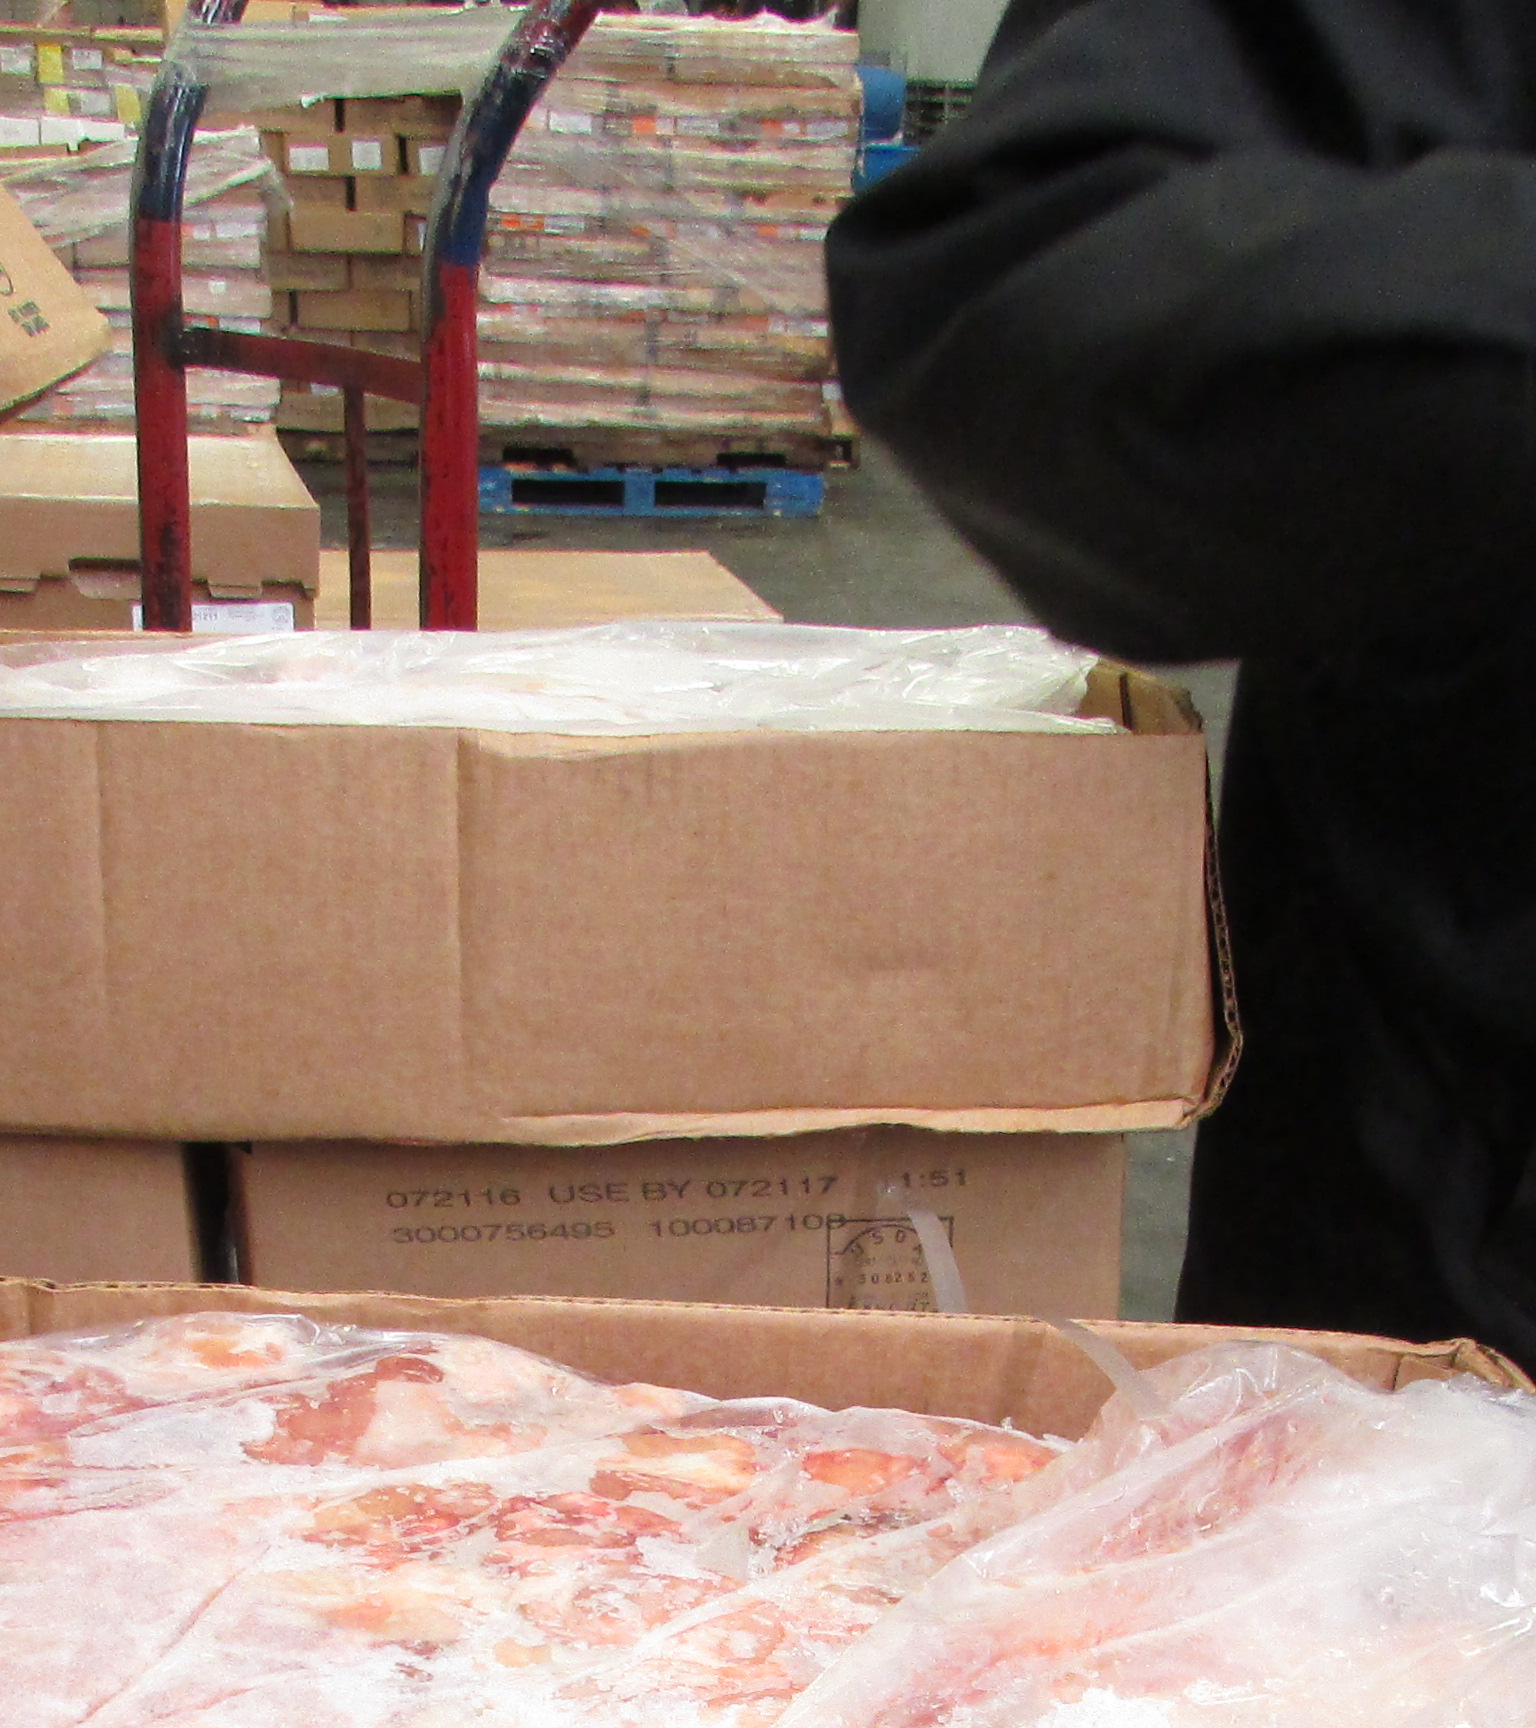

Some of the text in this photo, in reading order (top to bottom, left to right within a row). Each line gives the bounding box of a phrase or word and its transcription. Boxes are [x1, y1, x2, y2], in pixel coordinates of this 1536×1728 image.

[386, 1185, 522, 1209] 072116
[549, 1179, 629, 1204] USE
[641, 1179, 692, 1202] BY
[706, 1175, 838, 1199] 072117
[392, 1220, 616, 1246] 3000756495
